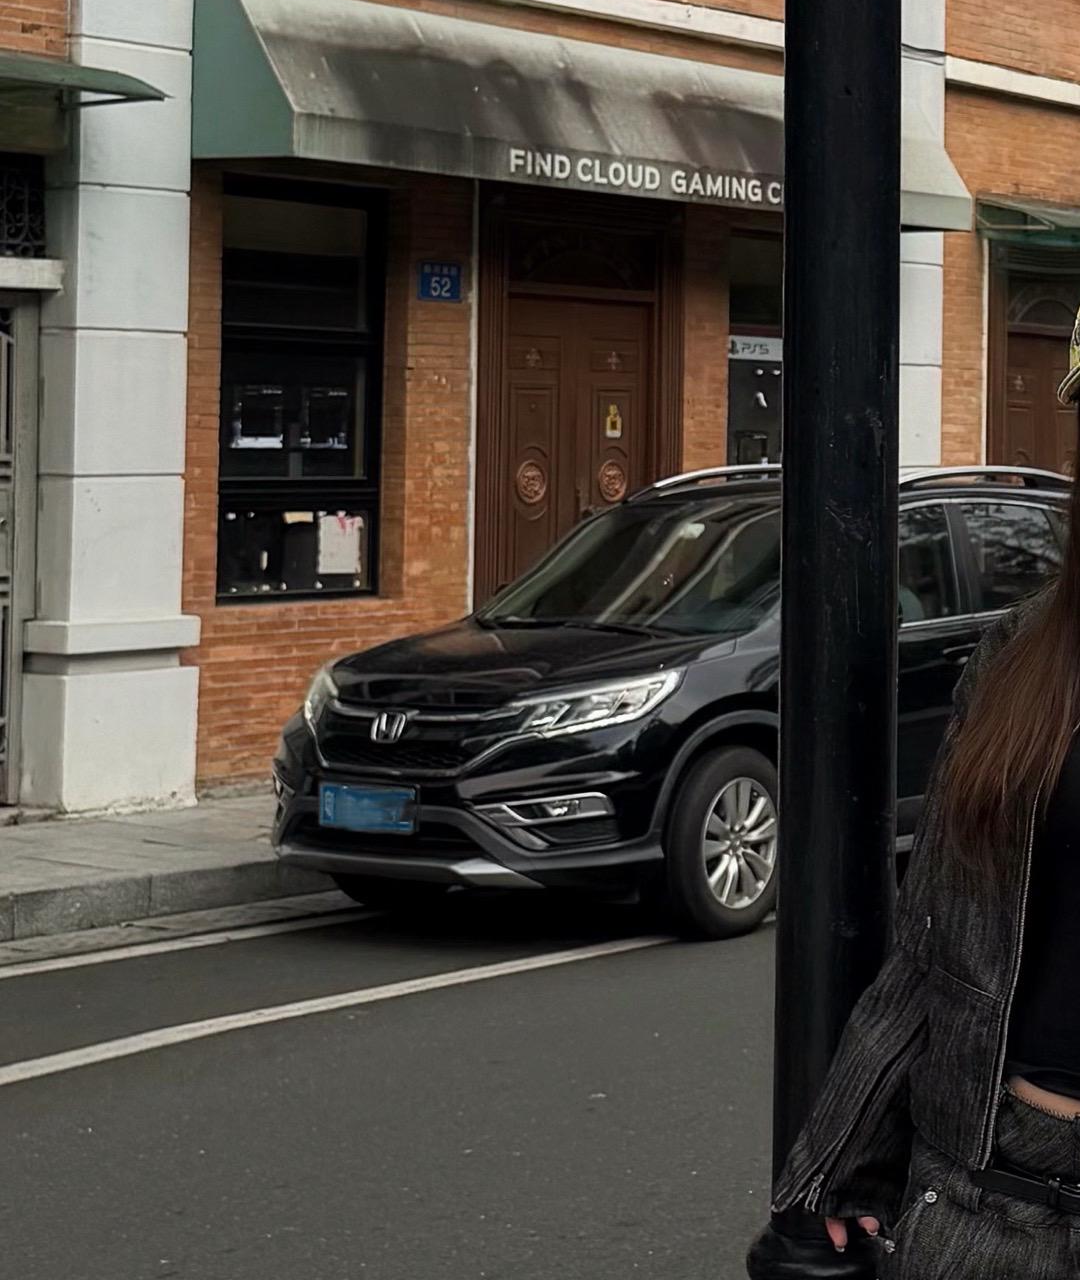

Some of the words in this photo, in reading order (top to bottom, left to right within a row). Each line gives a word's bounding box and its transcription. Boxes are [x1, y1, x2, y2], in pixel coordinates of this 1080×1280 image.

[509, 148, 571, 179] FIND
[576, 158, 660, 190] CLOUD
[670, 170, 762, 202] GAMING
[767, 181, 784, 204] C
[431, 276, 451, 297] 52
[741, 342, 769, 355] PS5
